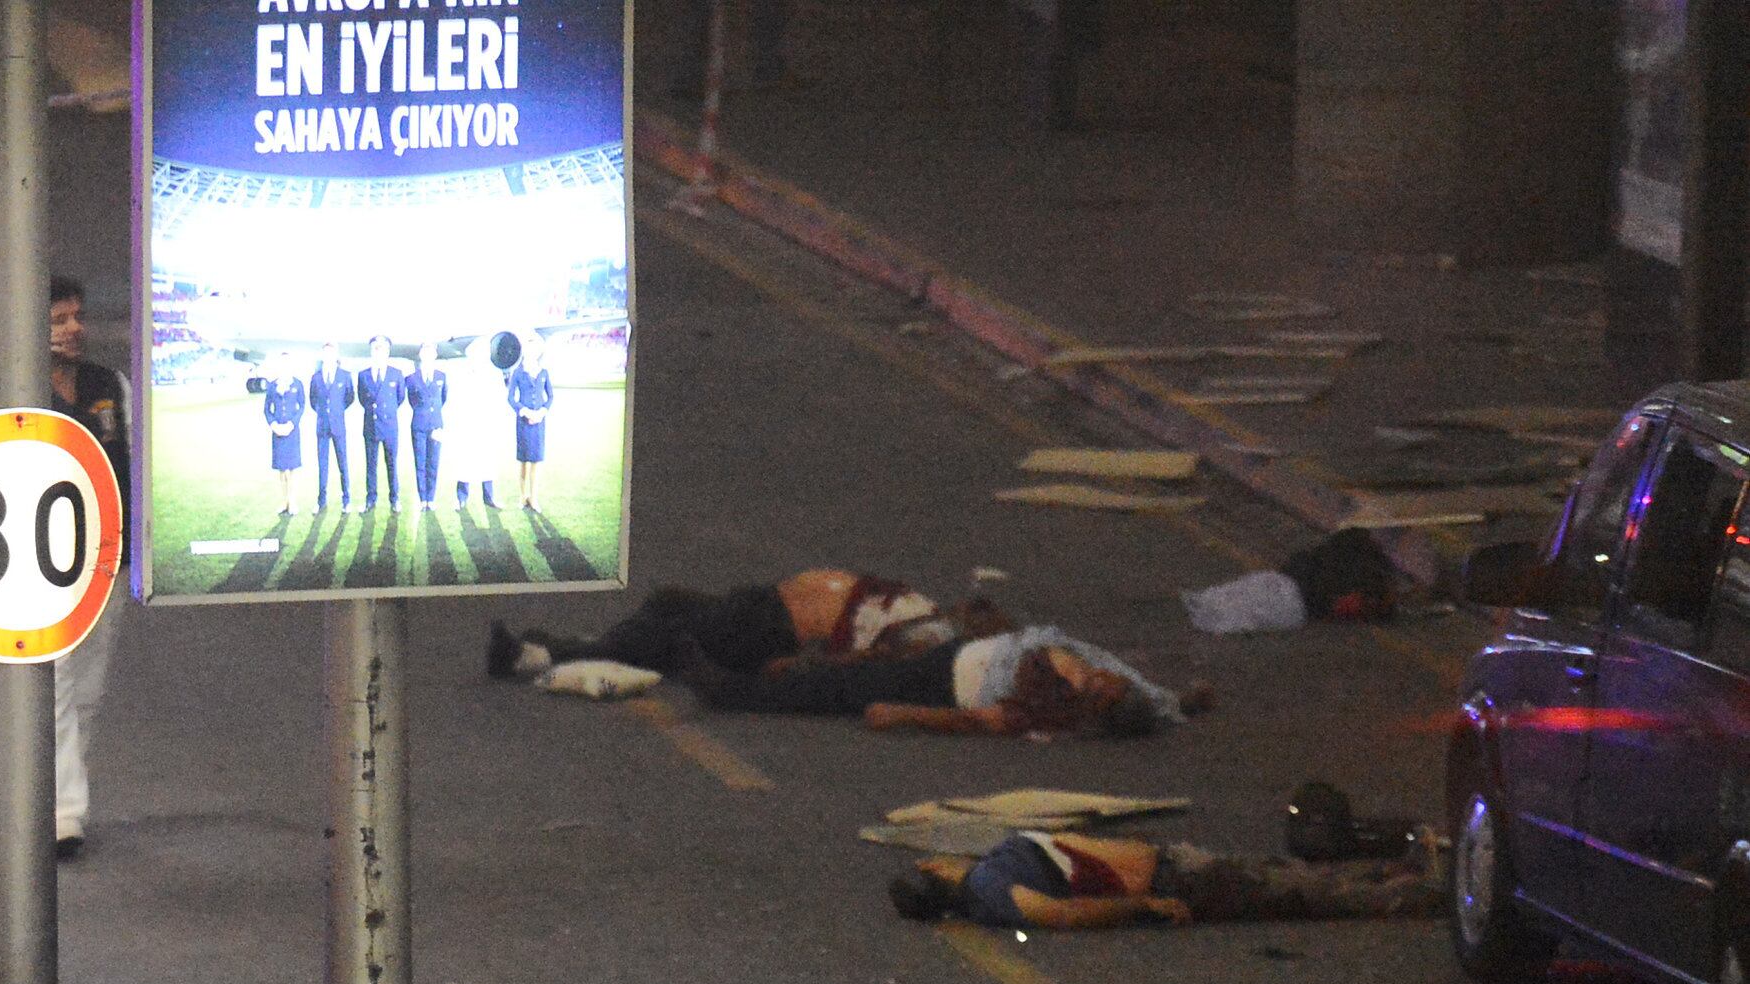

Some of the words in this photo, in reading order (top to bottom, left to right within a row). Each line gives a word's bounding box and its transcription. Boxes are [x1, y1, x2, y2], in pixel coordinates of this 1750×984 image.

[256, 23, 323, 96] EN
[340, 16, 519, 94] İYİLERİ
[254, 107, 383, 153] SAHAYA
[390, 103, 519, 156] ÇIKIYOR
